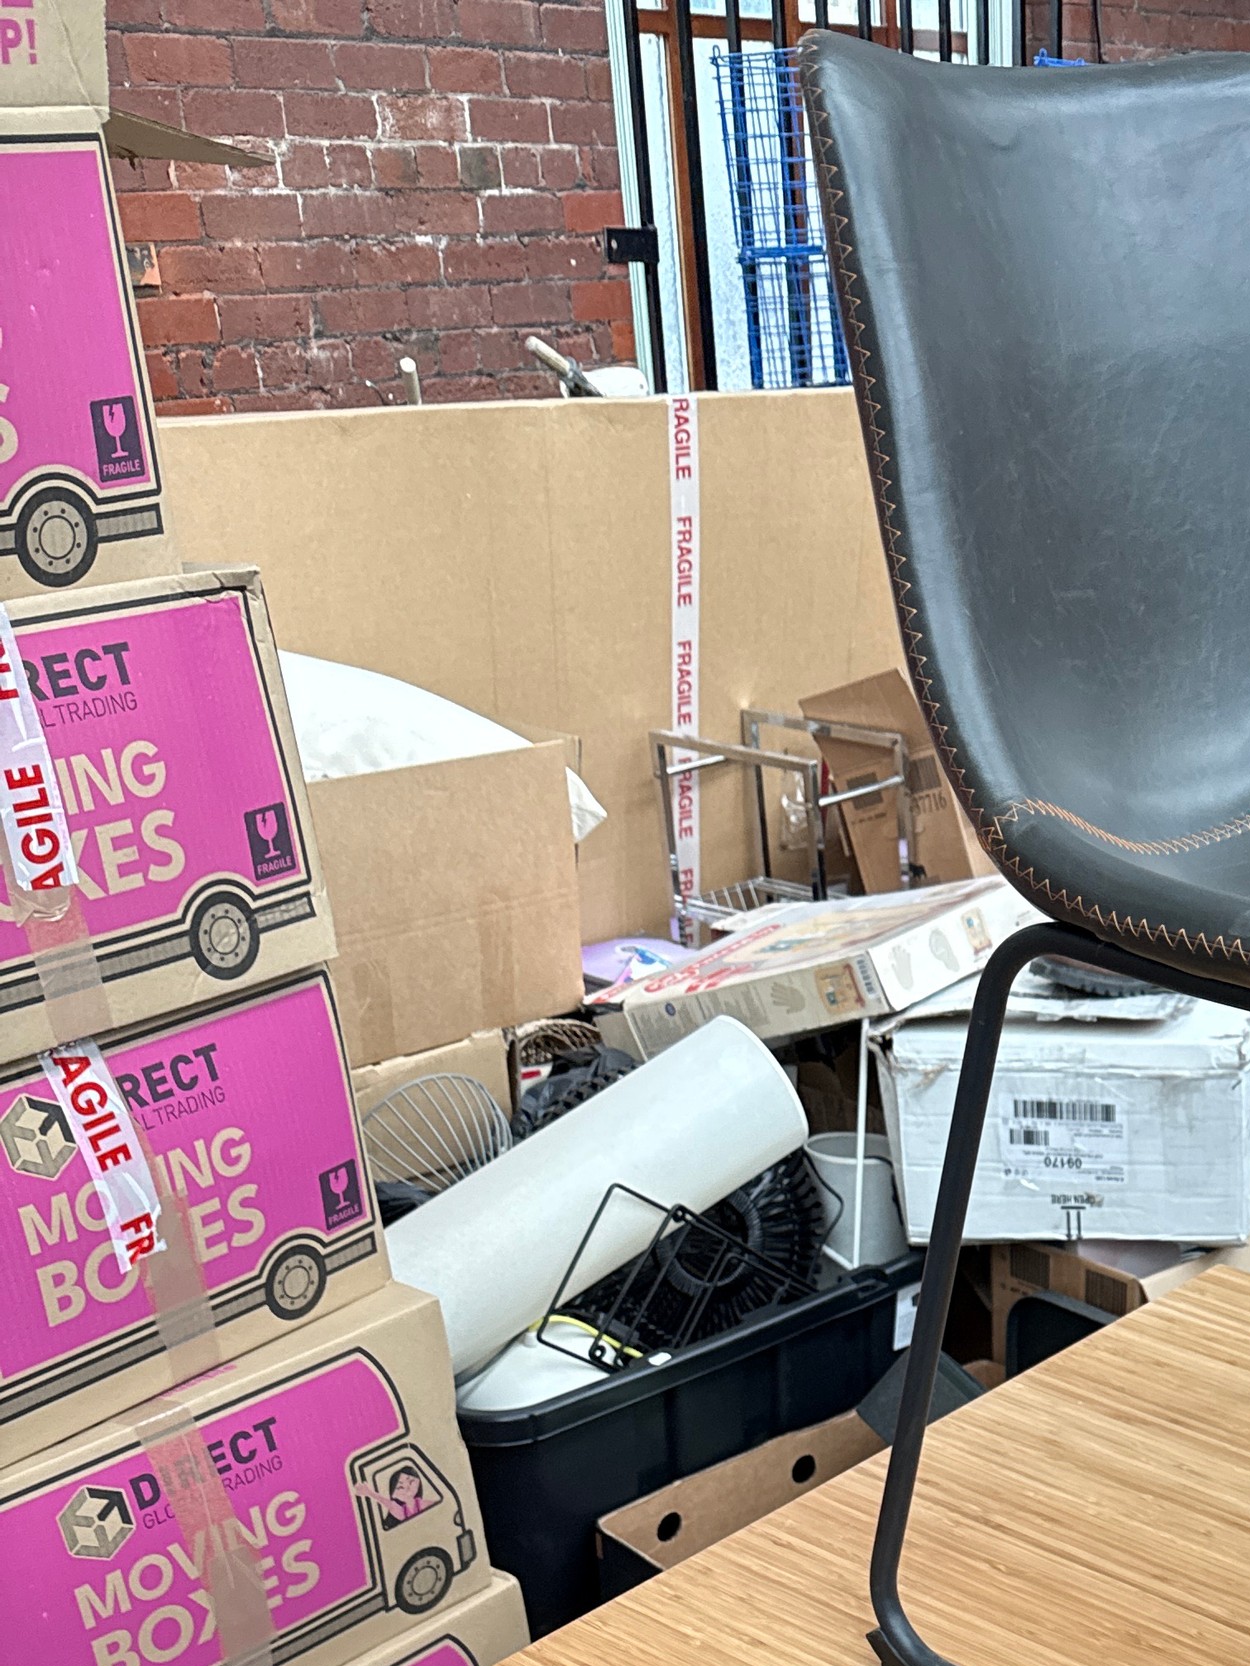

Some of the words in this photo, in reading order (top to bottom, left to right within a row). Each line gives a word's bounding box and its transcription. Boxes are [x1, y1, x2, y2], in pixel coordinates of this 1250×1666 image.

[103, 459, 141, 477] FRAGILE
[672, 398, 692, 481] RAGILE
[677, 516, 693, 607] FRAGILE
[22, 641, 132, 702] RECT
[677, 640, 692, 725] FRAGILE
[53, 692, 138, 726] TRADING
[54, 740, 166, 816] ING
[257, 856, 292, 875] FRAGILE
[115, 1042, 219, 1112] RECT
[153, 1086, 226, 1126] TRADING
[53, 1054, 132, 1173] AGILE
[18, 1127, 251, 1256] MOING
[1044, 1156, 1082, 1169] 09170
[328, 1203, 360, 1226] FRAGILE
[222, 1455, 283, 1492] RADING
